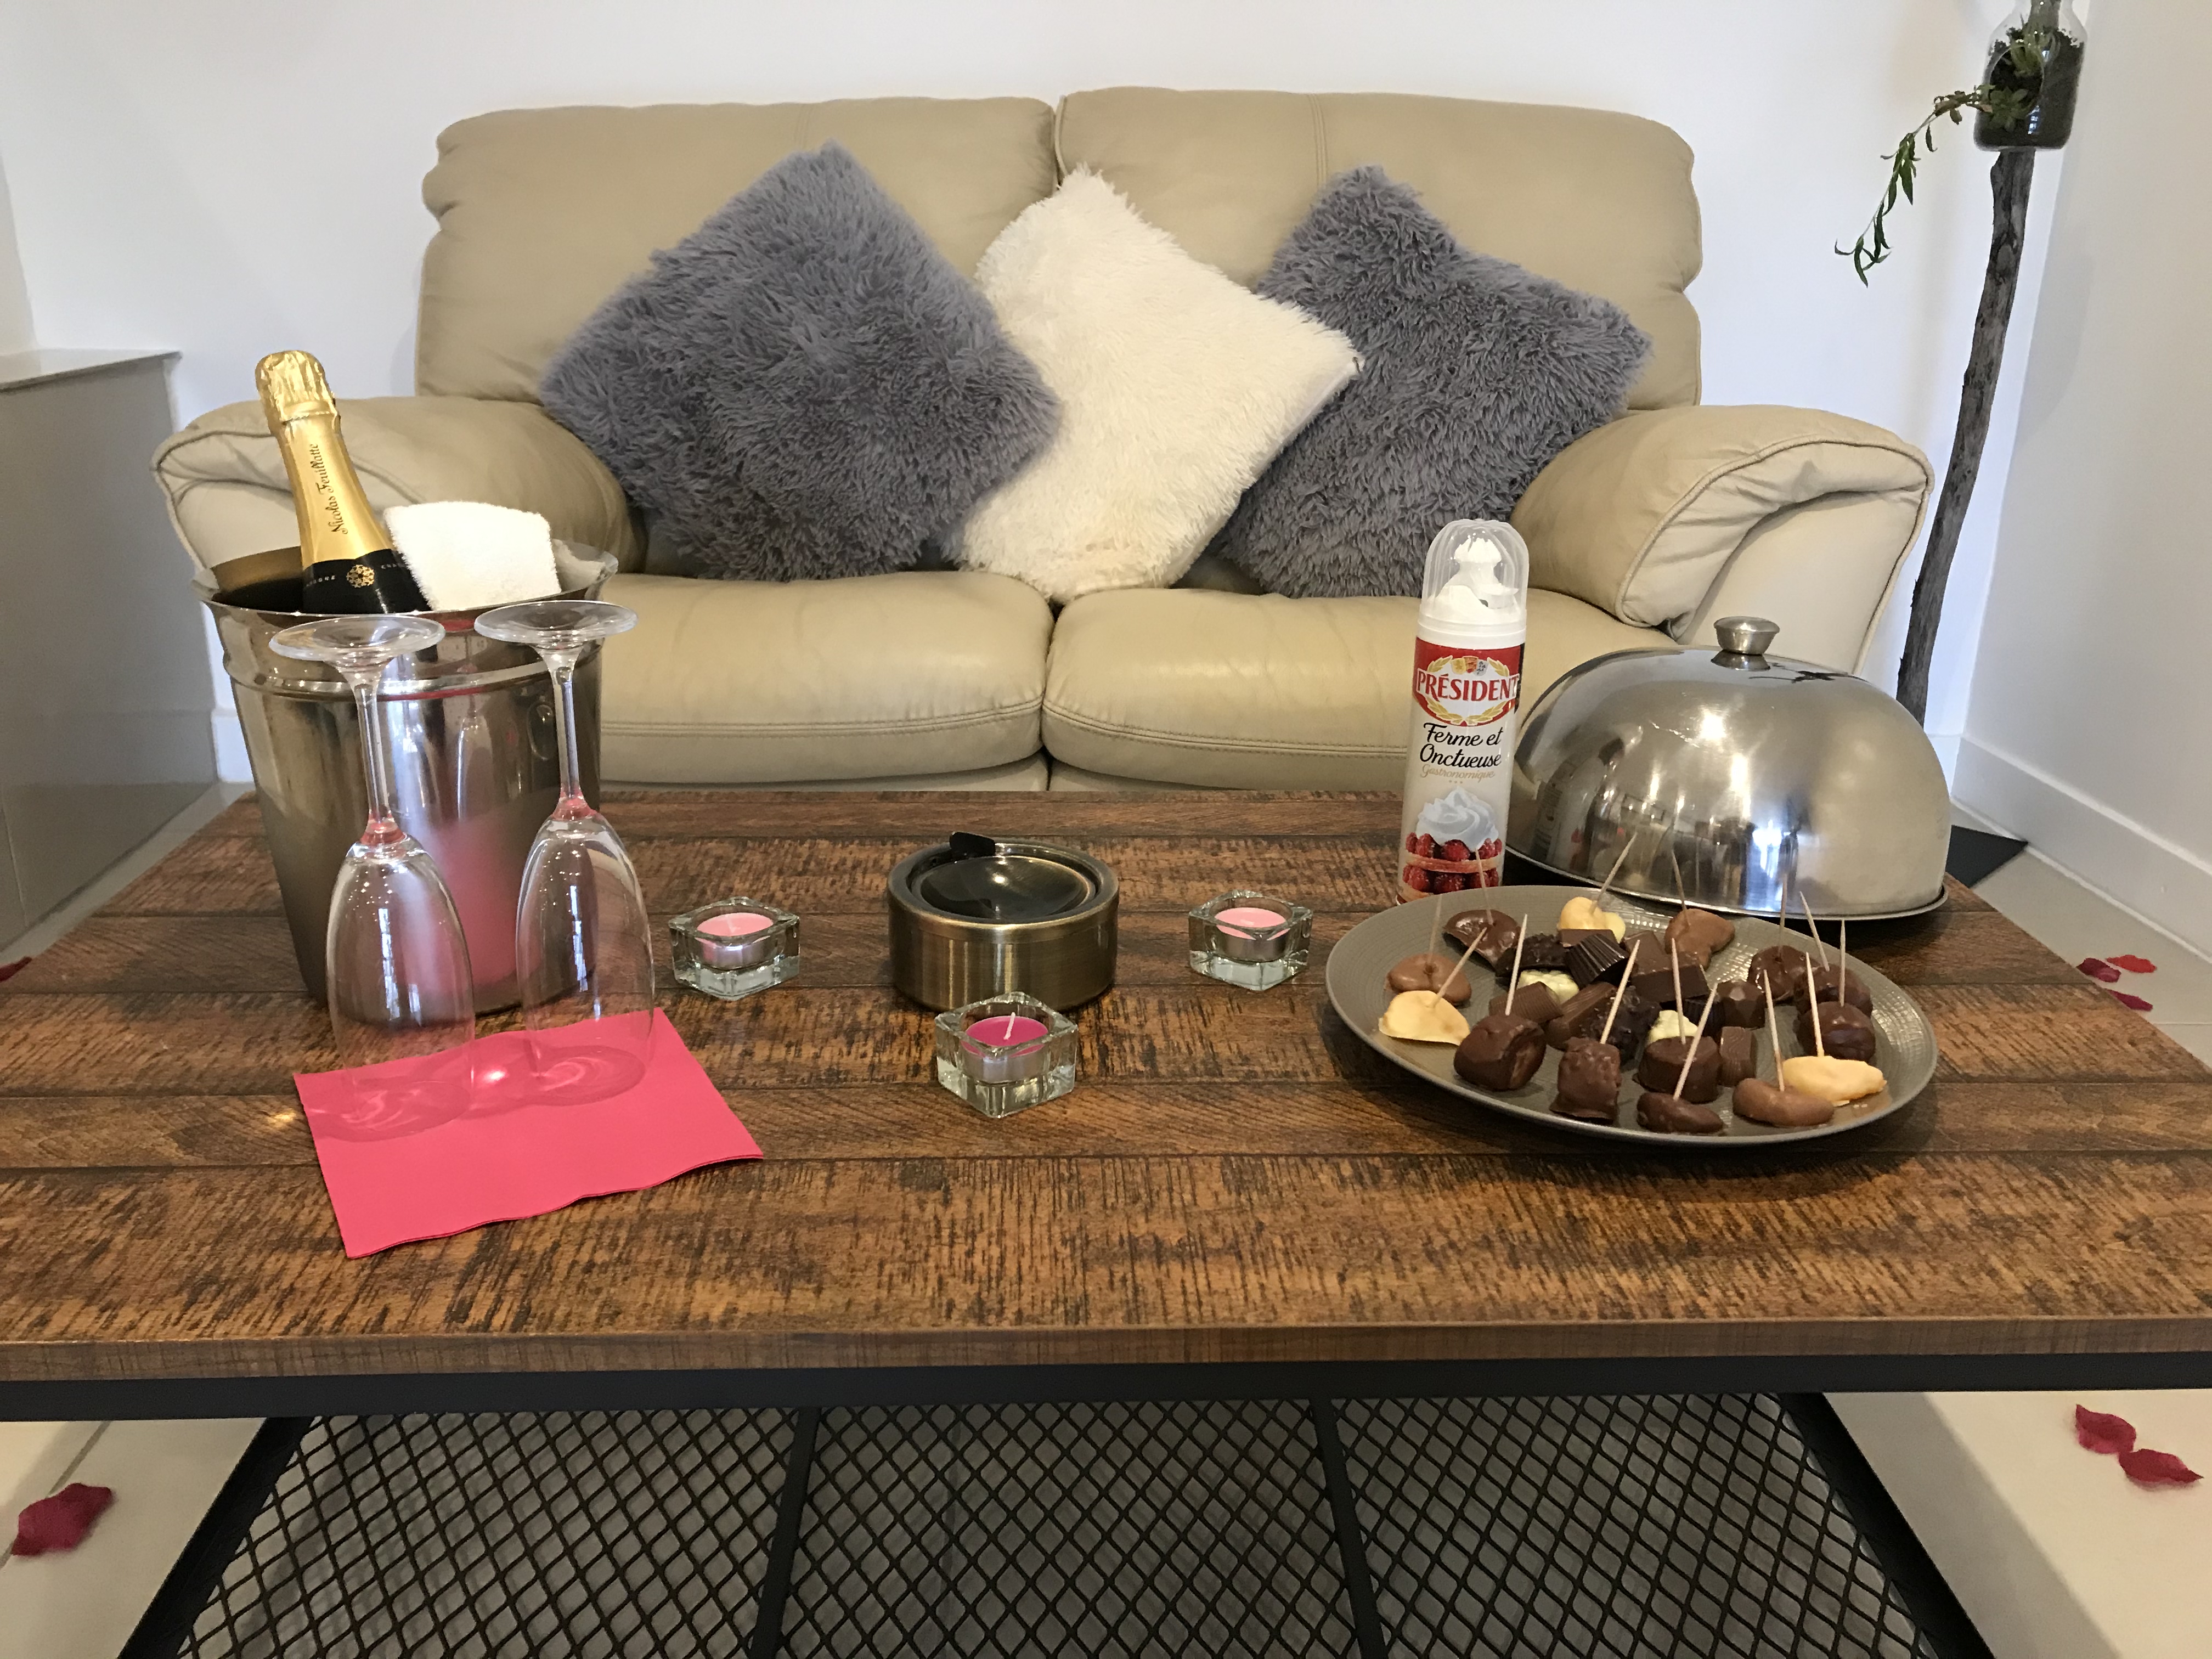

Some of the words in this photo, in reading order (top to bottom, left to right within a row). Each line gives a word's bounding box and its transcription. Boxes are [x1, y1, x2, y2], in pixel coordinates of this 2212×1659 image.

[309, 443, 334, 495] Feuillatte
[325, 495, 348, 534] Nicolas
[1417, 669, 1519, 702] PRÉSIDENT
[1423, 722, 1483, 747] Ferme
[1486, 726, 1504, 746] et
[1419, 743, 1502, 768] Onctueuse
[1420, 764, 1496, 783] Gastronomique
